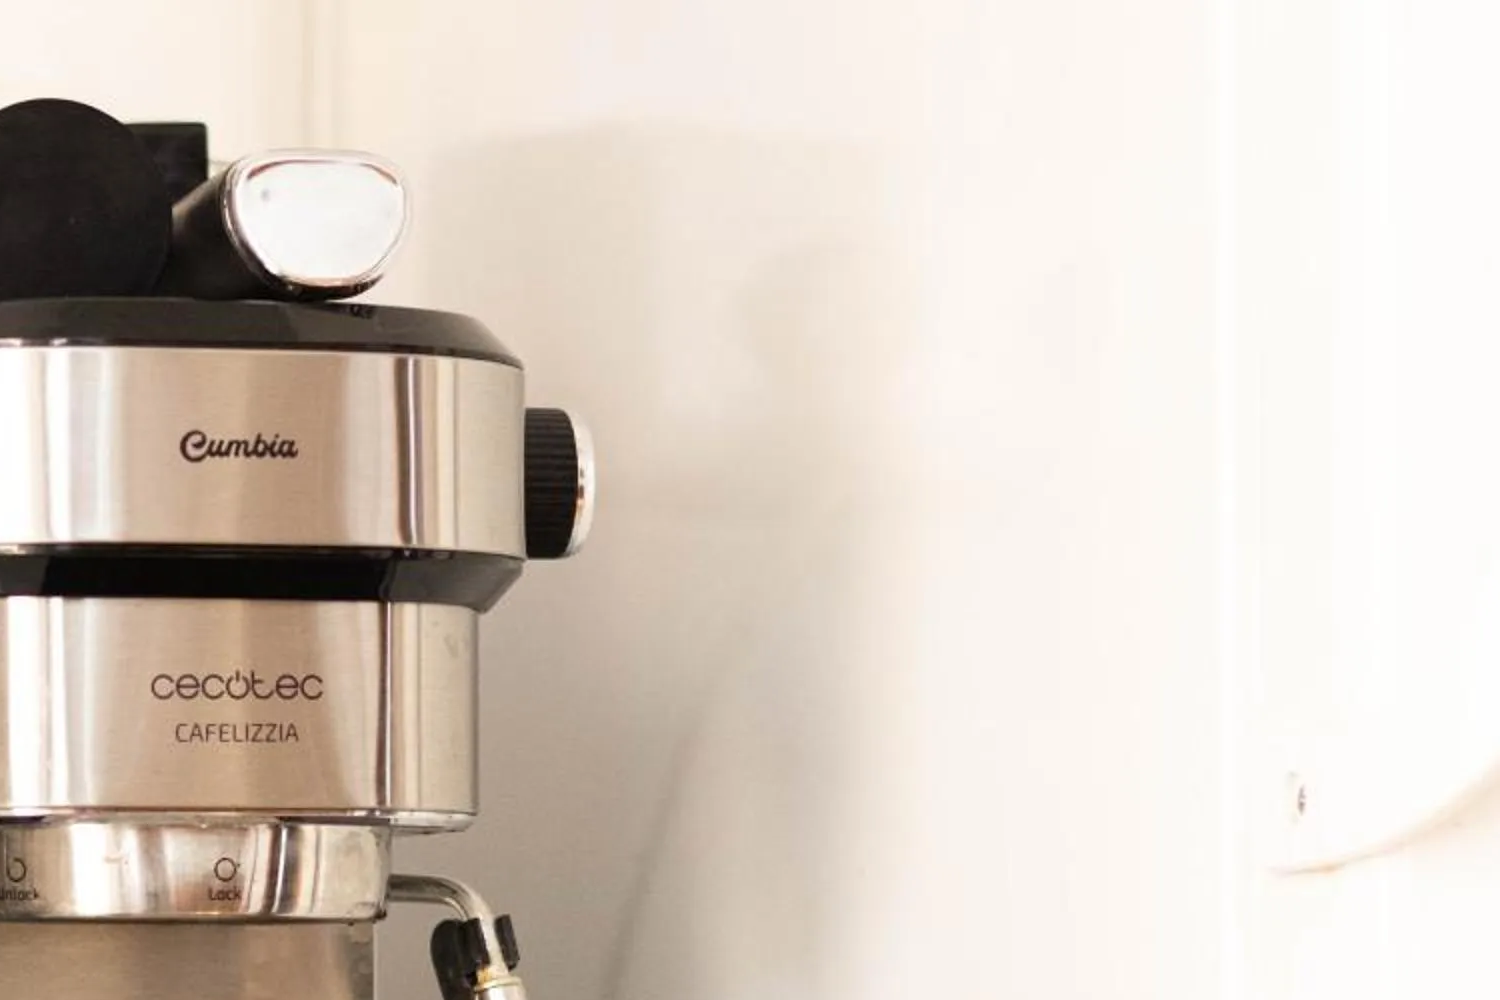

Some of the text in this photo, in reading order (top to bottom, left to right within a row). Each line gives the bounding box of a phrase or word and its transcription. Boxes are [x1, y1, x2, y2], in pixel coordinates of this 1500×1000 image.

[180, 430, 298, 463] Cumbia
[151, 670, 323, 700] cecotec
[175, 723, 299, 743] CAFELIZZIA
[208, 887, 242, 901] Lock
